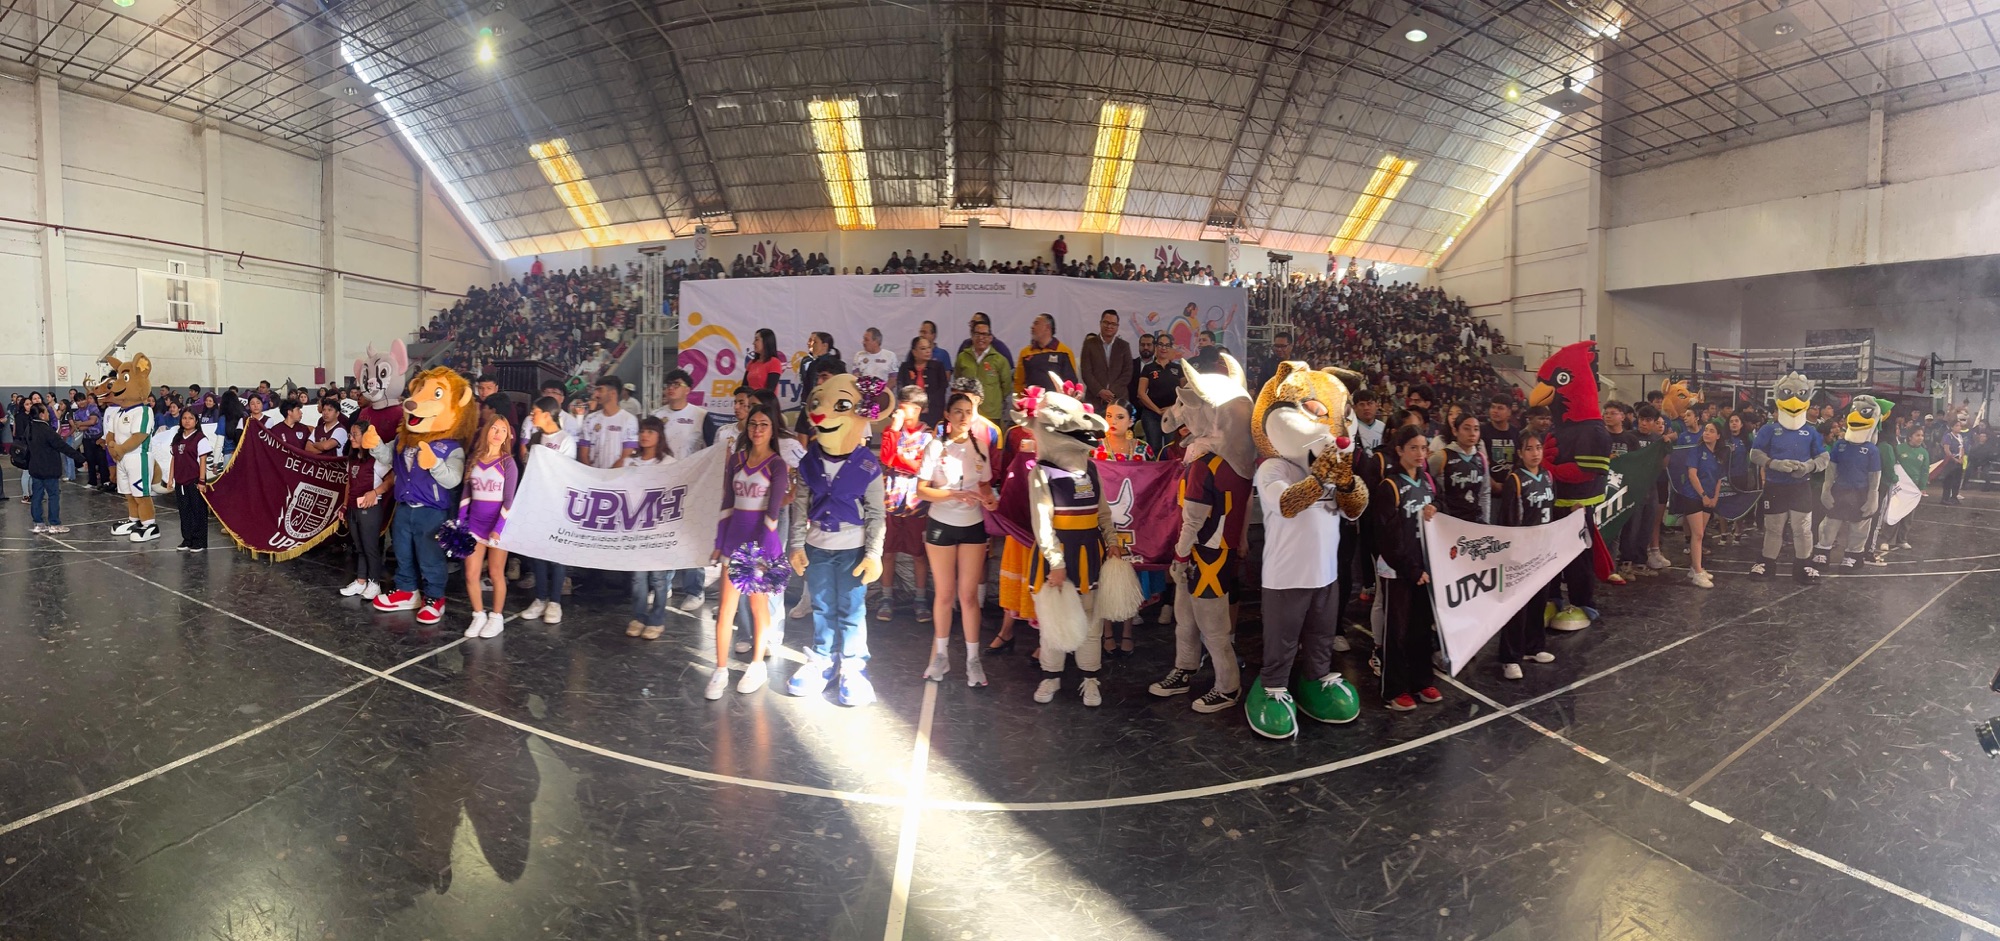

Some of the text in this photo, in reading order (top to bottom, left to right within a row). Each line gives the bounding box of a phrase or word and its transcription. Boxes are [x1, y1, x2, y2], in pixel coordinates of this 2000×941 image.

[955, 282, 1006, 291] EDUCACIÓN
[285, 457, 301, 472] DE
[301, 463, 315, 477] LA
[304, 483, 334, 497] UNIVERSIDAD
[1541, 508, 1551, 524] 3
[623, 544, 637, 552] de
[1445, 567, 1498, 609] UTXJ
